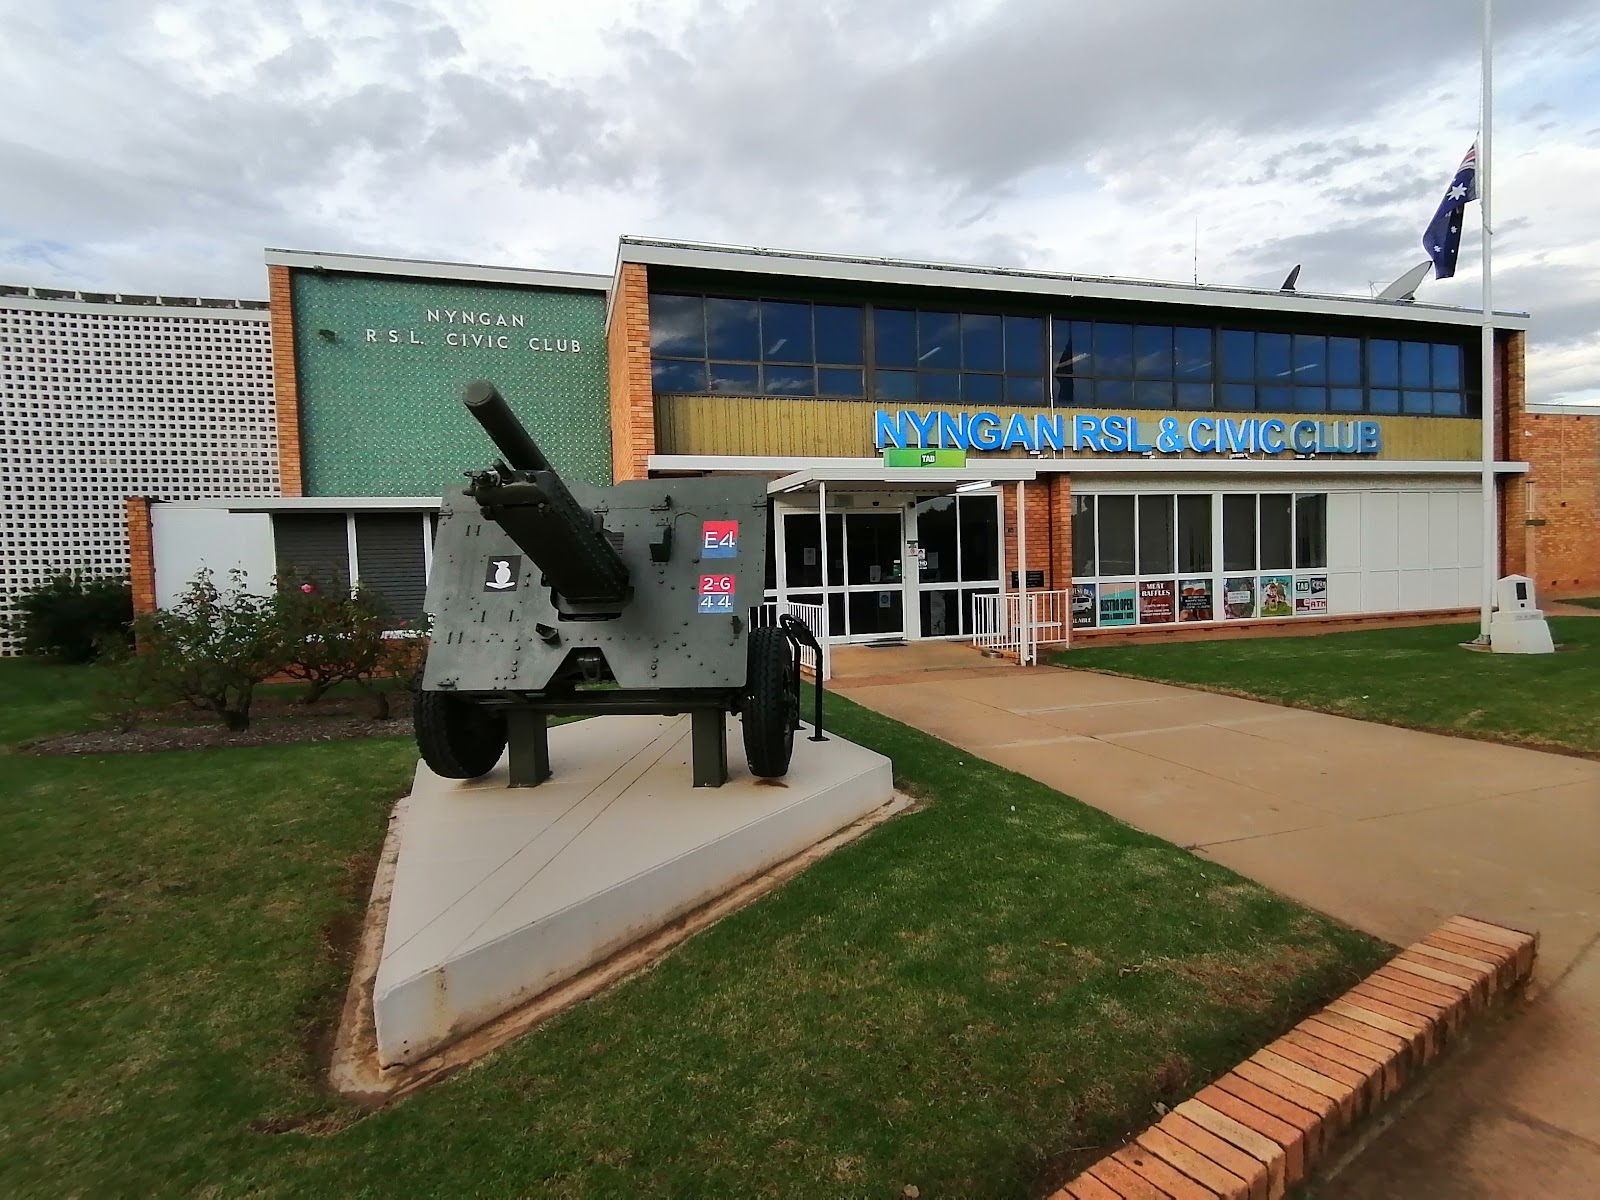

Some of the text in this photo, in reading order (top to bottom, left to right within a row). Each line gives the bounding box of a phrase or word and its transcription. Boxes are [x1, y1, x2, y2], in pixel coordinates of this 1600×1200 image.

[427, 309, 525, 328] NYNGAN
[446, 333, 509, 349] CIVIC
[529, 338, 581, 352] CLUB
[875, 410, 1383, 454] NYNGAN RSL & CIVIC CLUB
[922, 455, 935, 463] TAB
[704, 531, 736, 549] E4
[1311, 600, 1325, 608] ATM
